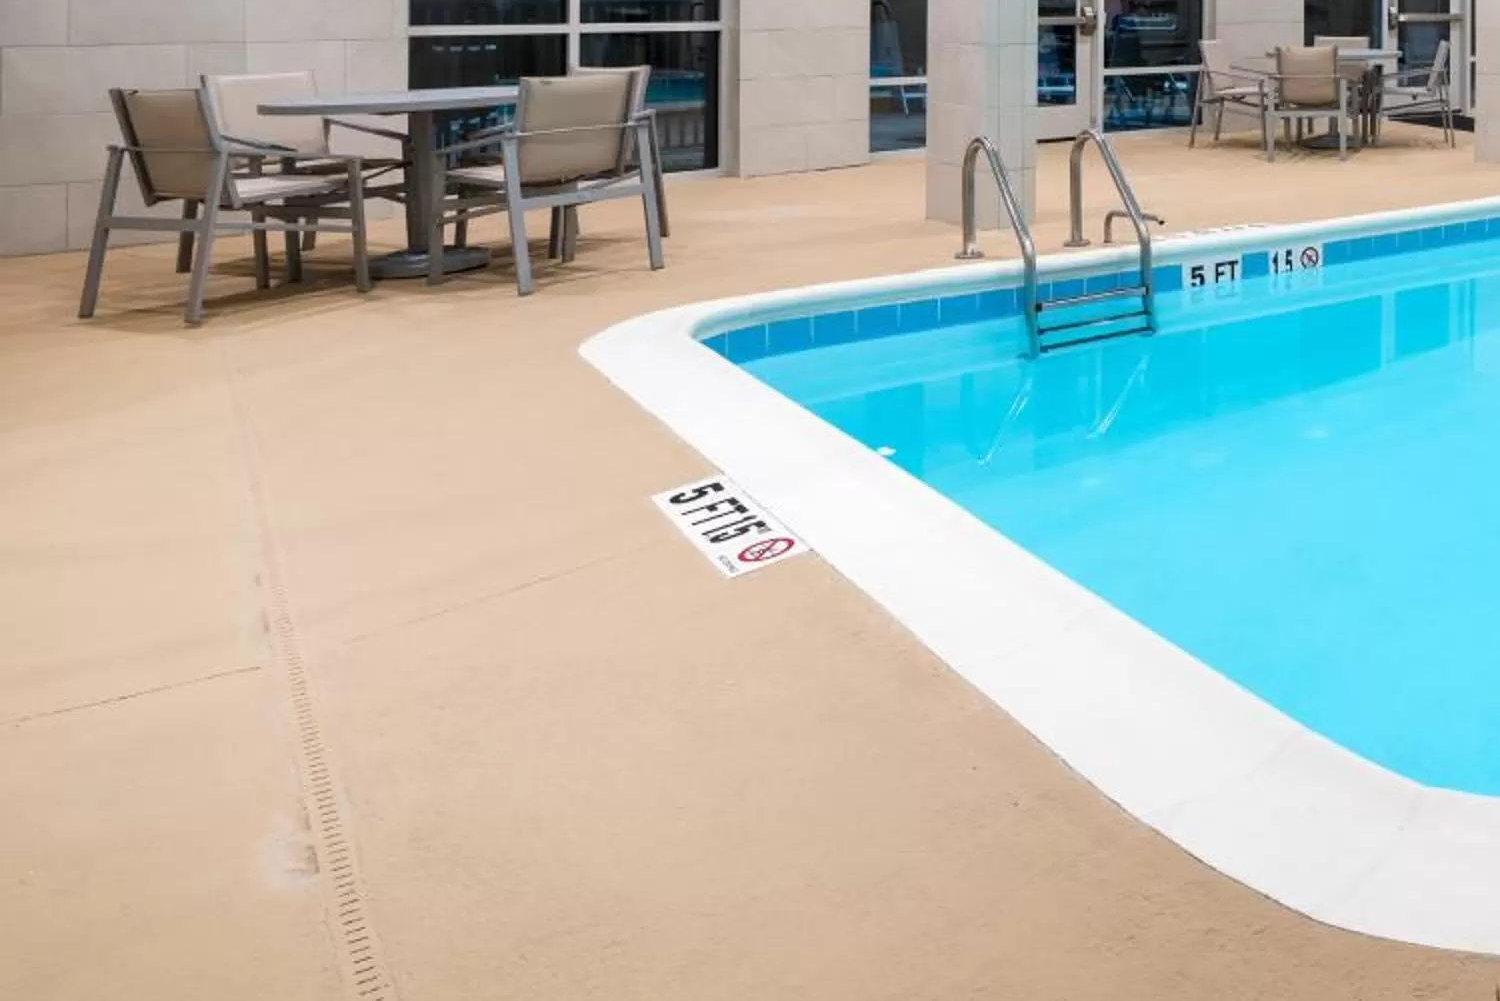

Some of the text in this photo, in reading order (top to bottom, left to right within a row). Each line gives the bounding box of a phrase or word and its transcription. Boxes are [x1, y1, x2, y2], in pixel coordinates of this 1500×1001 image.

[1191, 265, 1205, 287] 5
[1215, 260, 1238, 283] FT
[669, 482, 725, 504] 5
